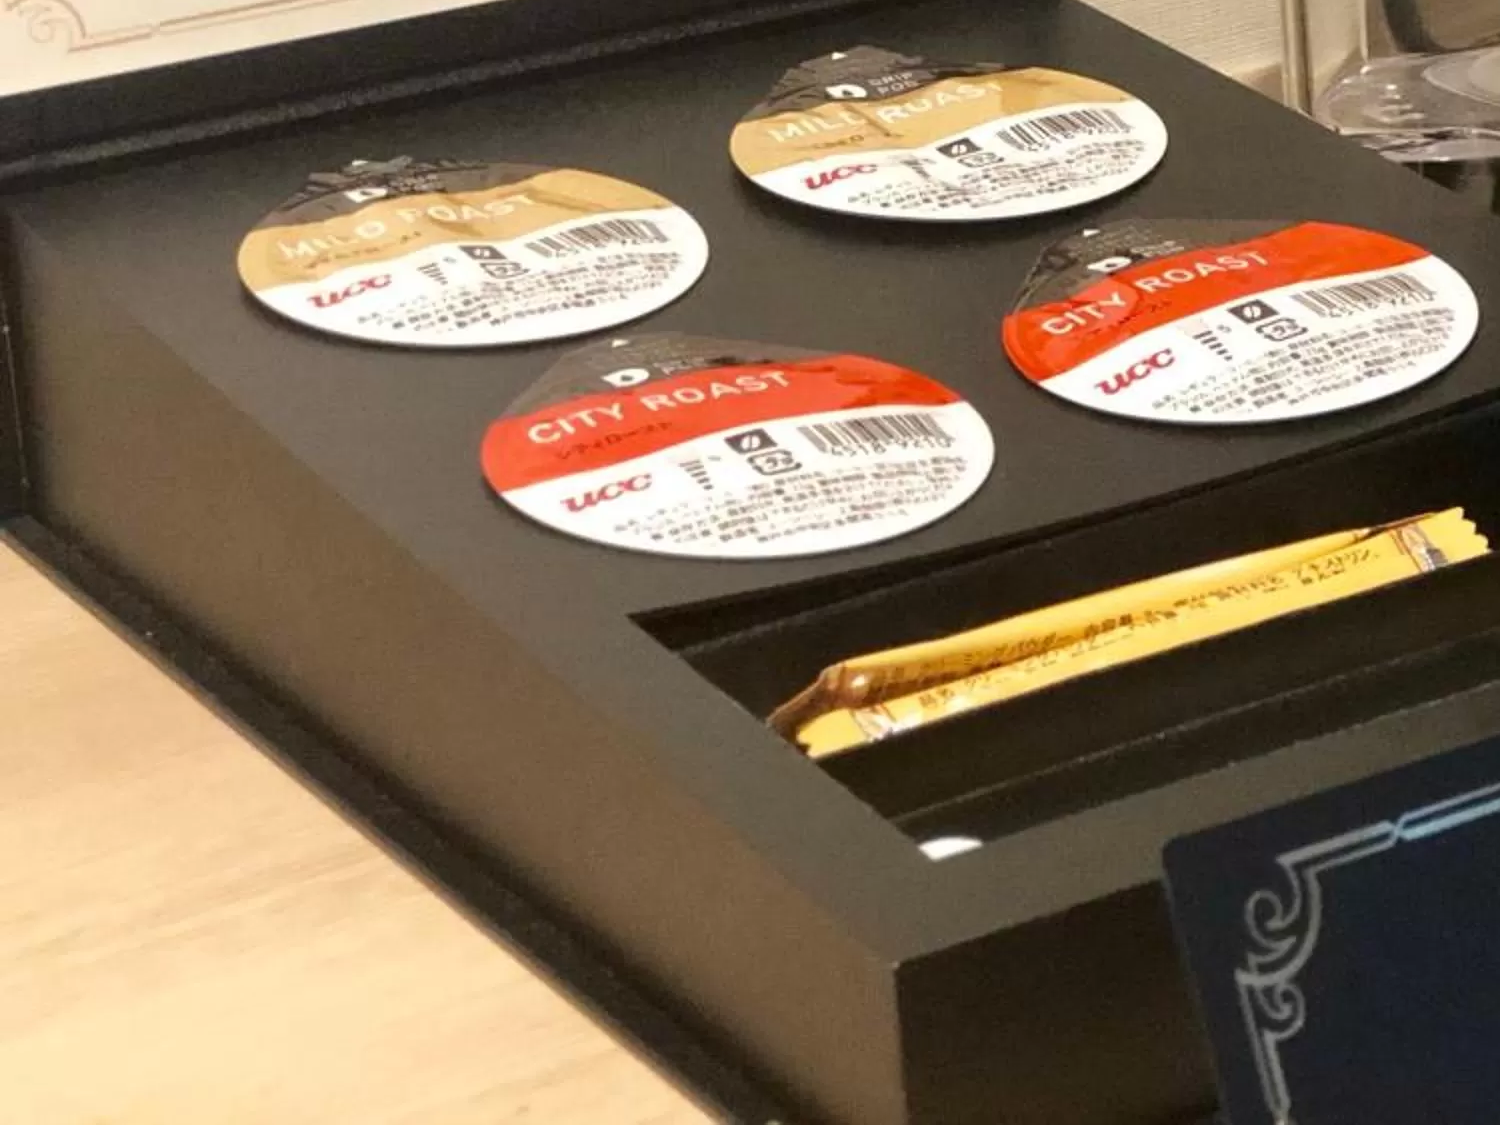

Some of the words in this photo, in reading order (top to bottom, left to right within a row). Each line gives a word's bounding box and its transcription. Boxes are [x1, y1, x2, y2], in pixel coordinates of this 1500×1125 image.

[1041, 291, 1127, 336] CITY
[1134, 250, 1269, 294] ROAST
[527, 403, 625, 445] CITY
[639, 370, 790, 412] ROAST
